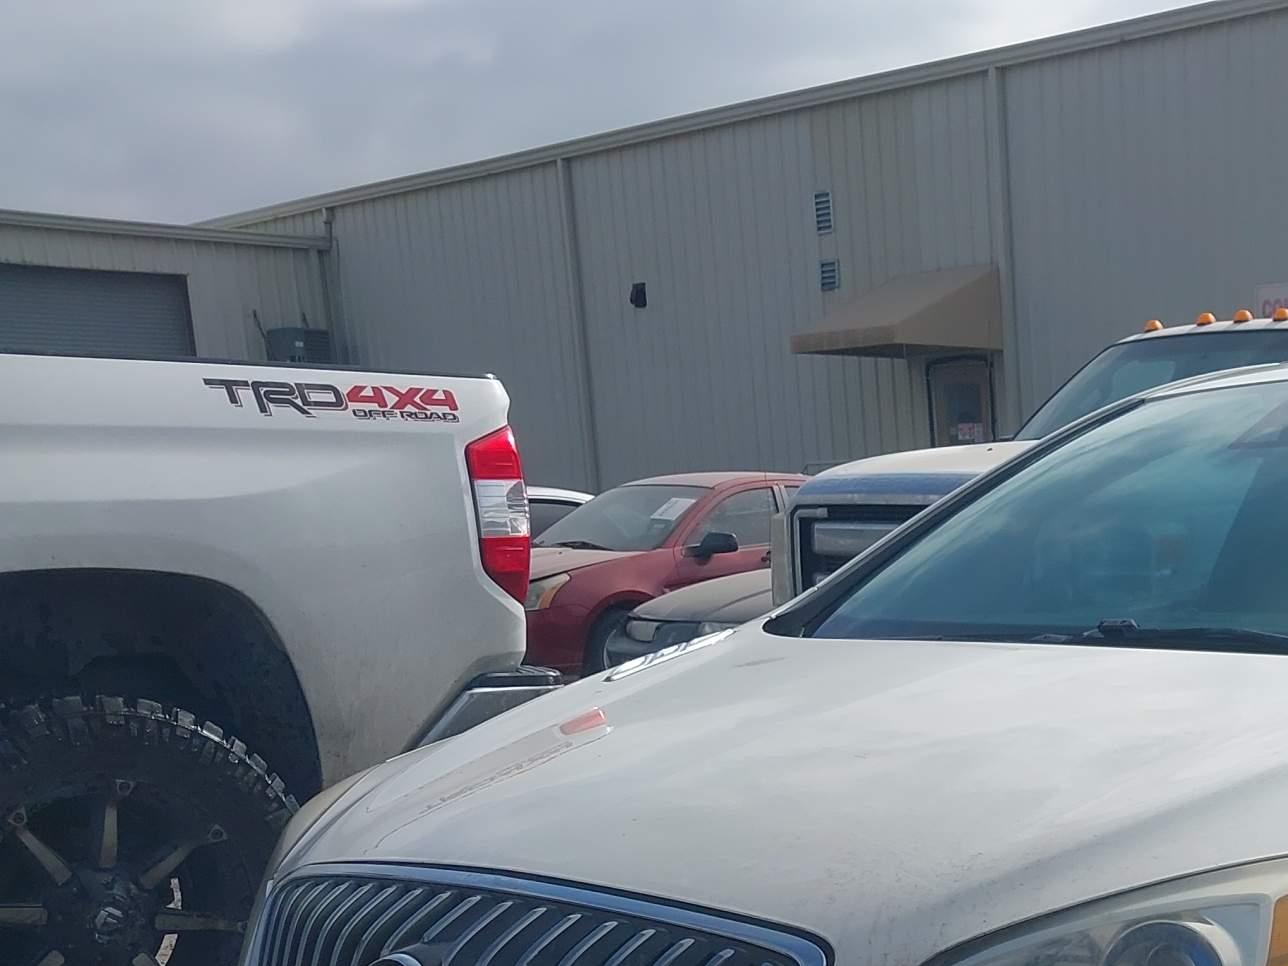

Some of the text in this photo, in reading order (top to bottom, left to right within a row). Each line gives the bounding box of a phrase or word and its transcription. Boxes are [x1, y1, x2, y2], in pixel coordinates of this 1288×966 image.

[203, 378, 349, 417] TRD
[352, 408, 460, 423] OFF ROAD
